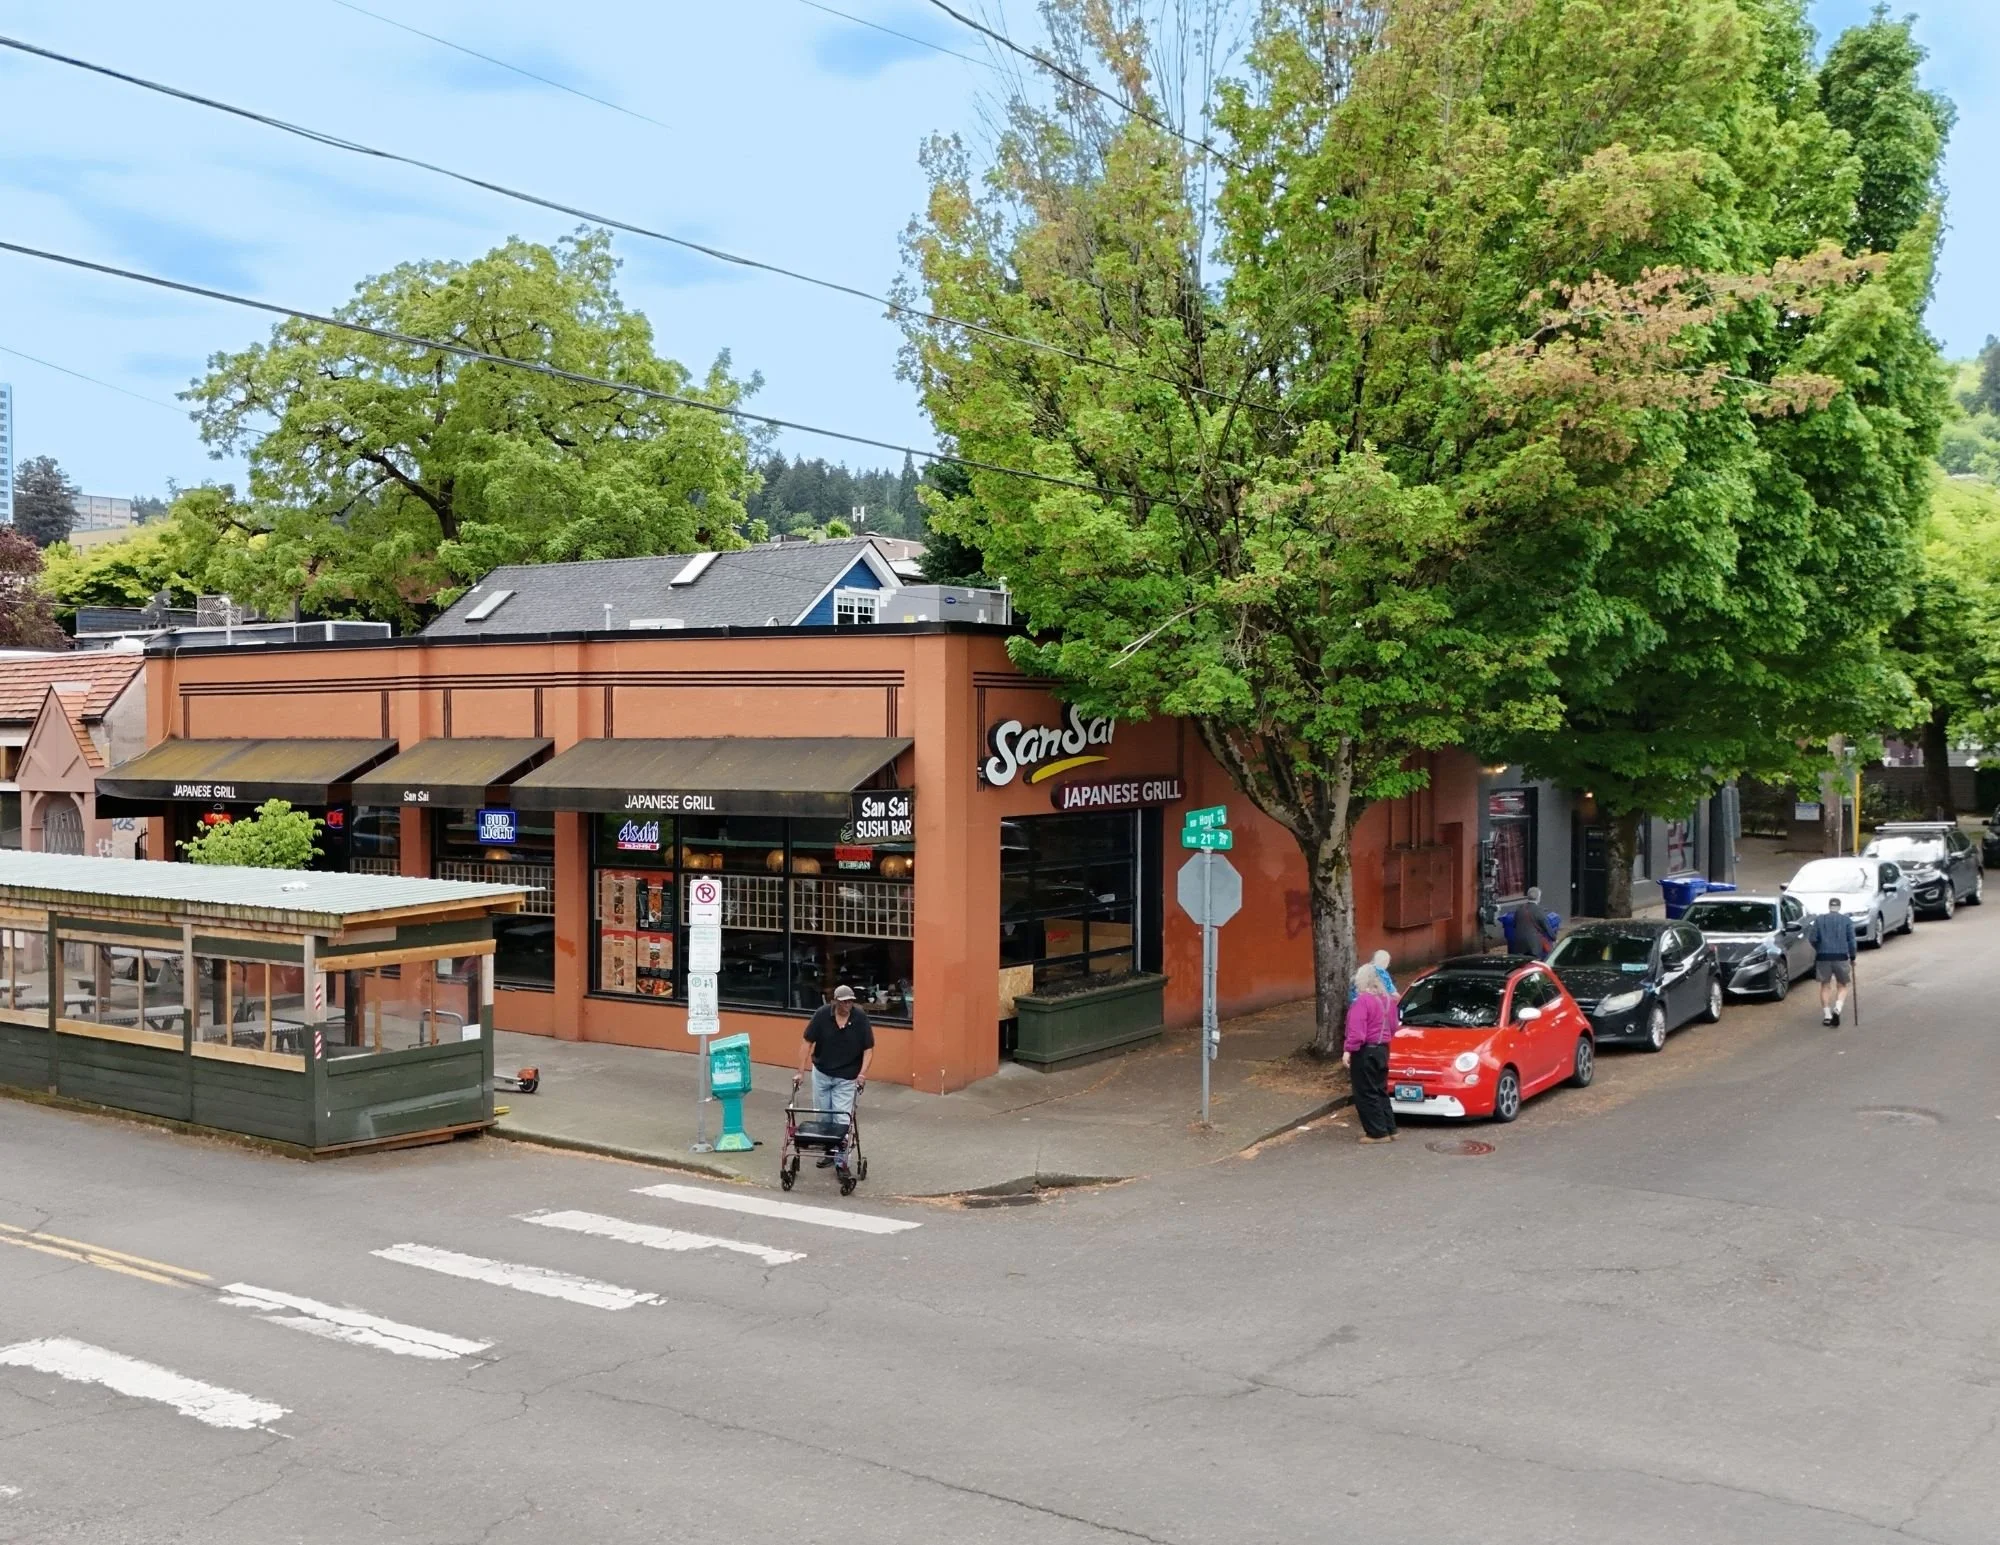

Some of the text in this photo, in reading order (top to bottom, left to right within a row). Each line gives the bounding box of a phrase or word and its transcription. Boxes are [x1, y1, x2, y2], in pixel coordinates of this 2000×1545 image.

[173, 785, 237, 799] JAPANESE GRILL
[403, 790, 429, 802] San Sai
[1063, 780, 1182, 809] JAPANESE GRILL
[624, 794, 716, 811] JAPANESE GRILL
[861, 796, 909, 818] San Sai
[485, 814, 509, 827] BUD
[1199, 813, 1215, 827] Hoyt
[481, 826, 514, 840] LIGHT
[618, 819, 659, 843] Asahi
[856, 819, 912, 838] SUSHI BAR
